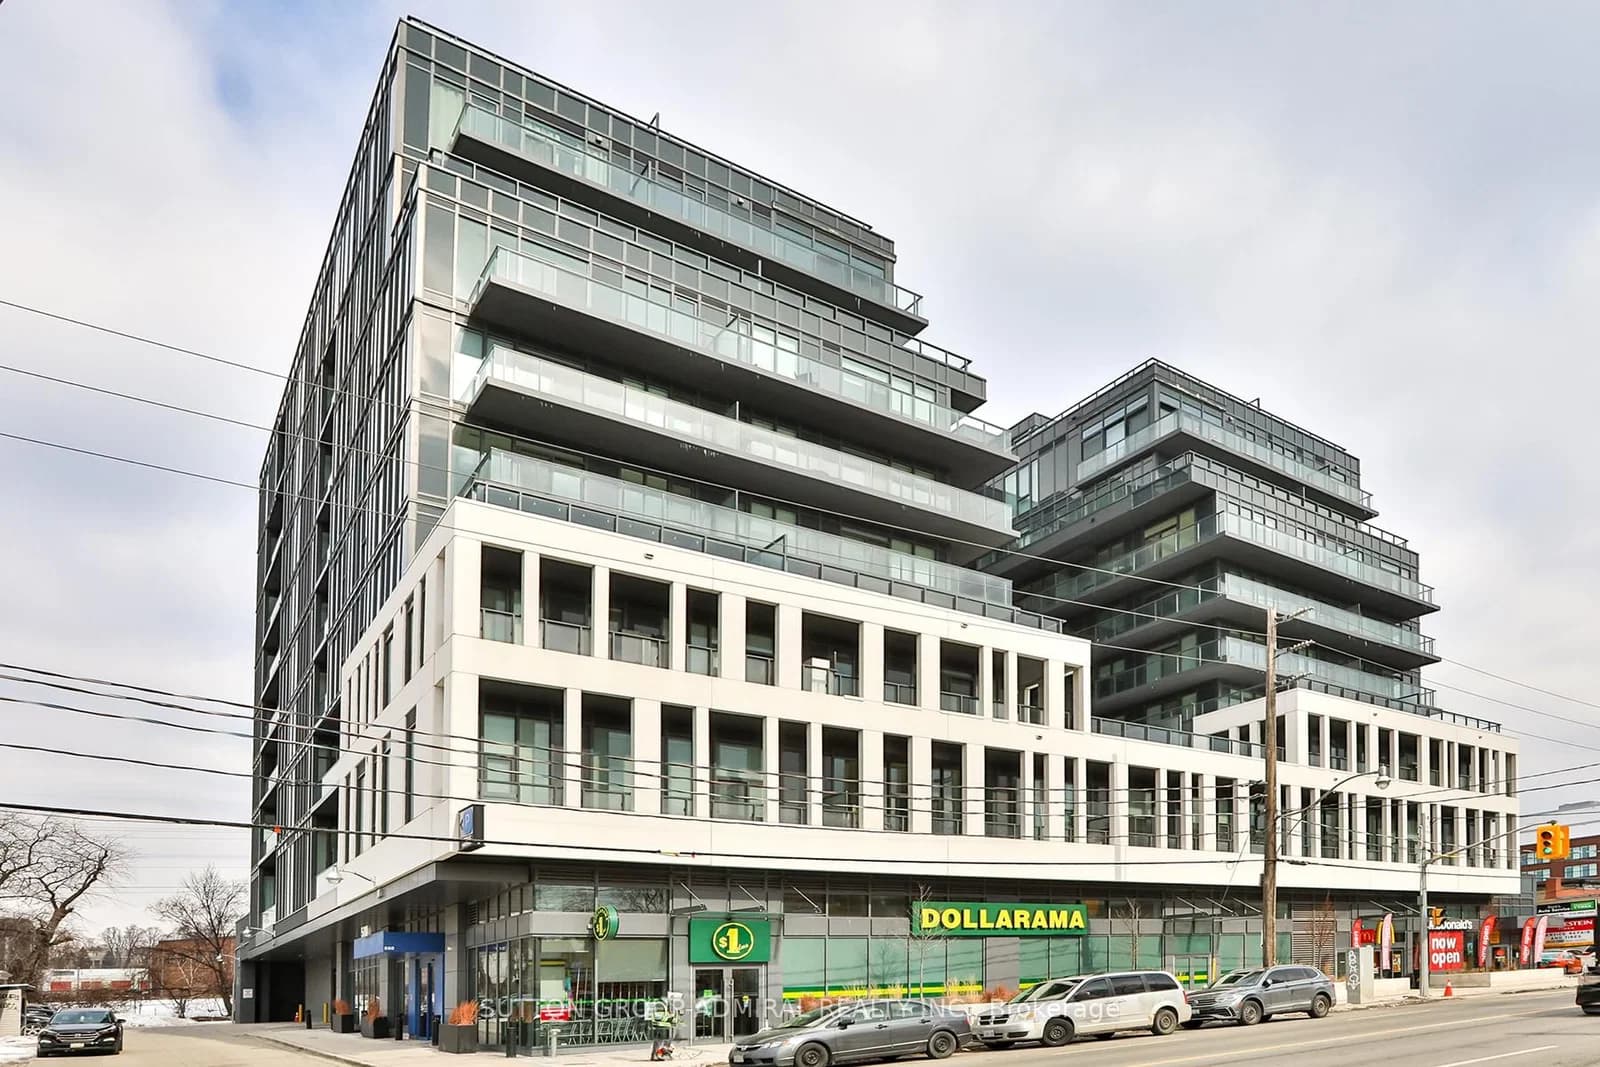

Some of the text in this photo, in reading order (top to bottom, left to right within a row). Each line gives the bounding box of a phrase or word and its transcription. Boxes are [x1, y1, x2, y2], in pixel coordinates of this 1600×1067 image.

[921, 908, 1085, 929] DOLLARAMA
[1432, 938, 1456, 950] now
[1432, 952, 1460, 968] open
